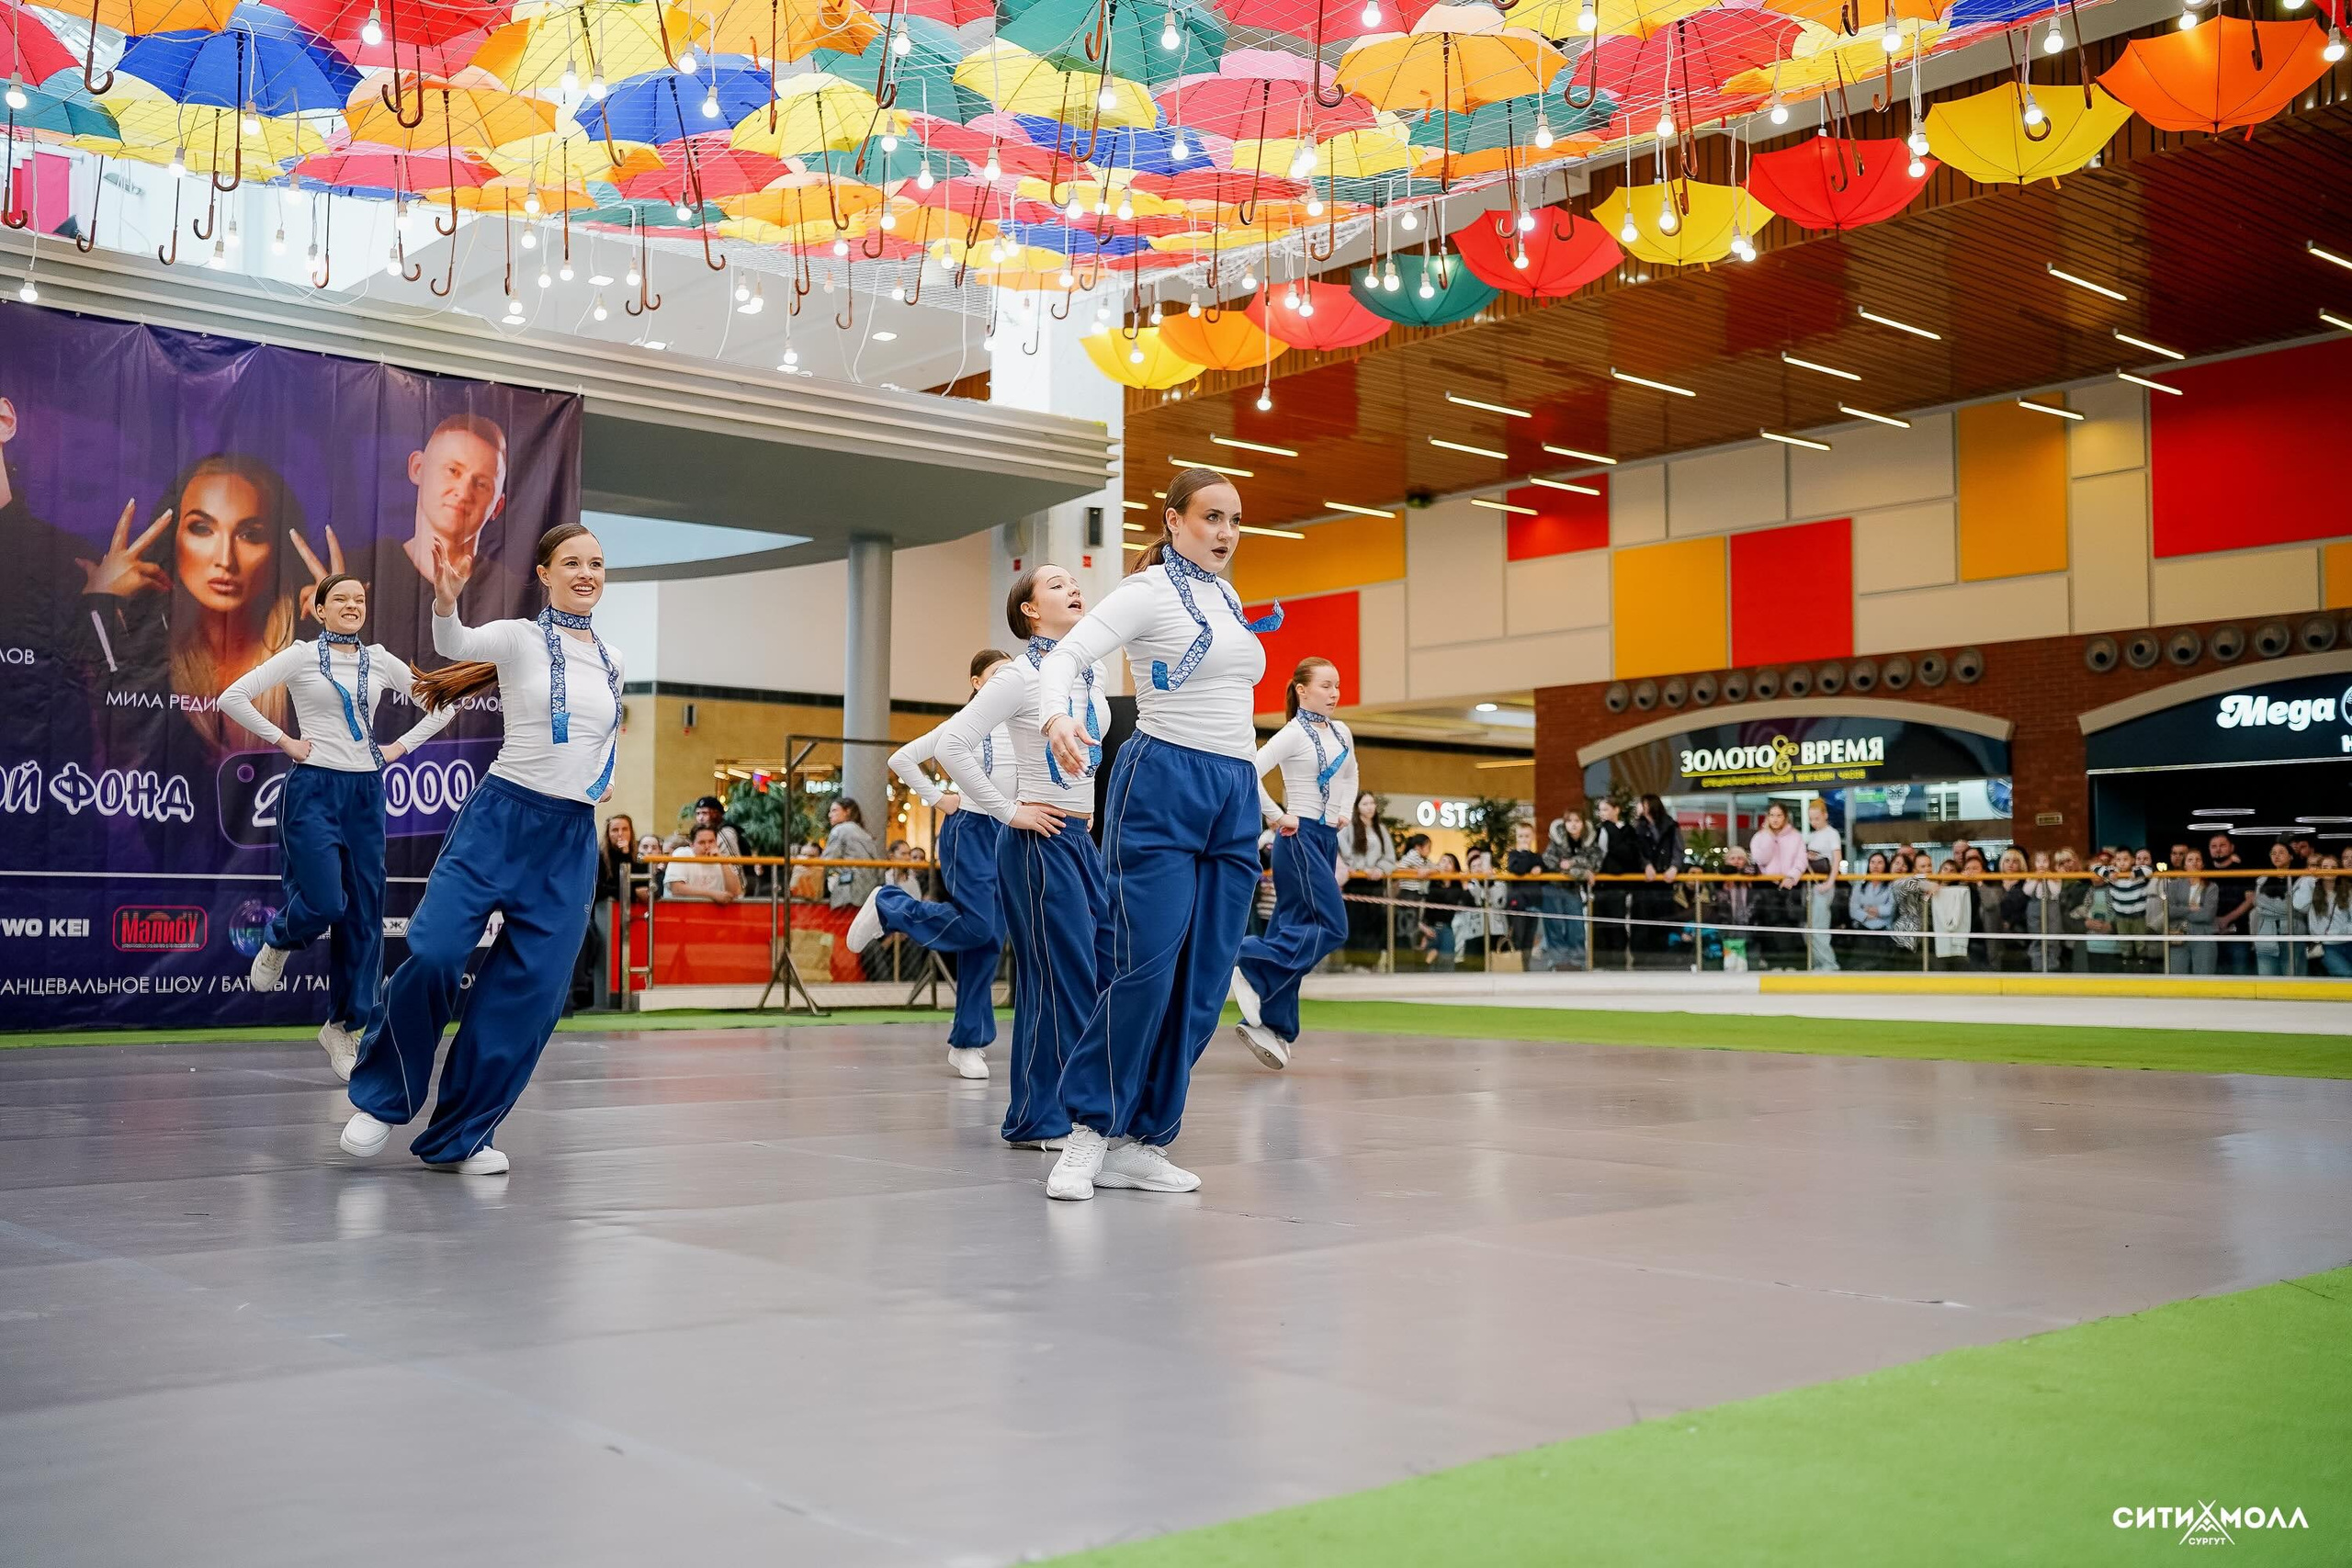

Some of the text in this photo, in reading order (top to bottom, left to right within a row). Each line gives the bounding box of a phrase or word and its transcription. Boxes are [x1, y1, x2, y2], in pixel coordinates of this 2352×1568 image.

[106, 691, 221, 714] МИЛА РЕДИ
[2216, 694, 2335, 731] Mega
[1679, 744, 1777, 773] ЗОЛОТО
[1801, 736, 1884, 765] ВРЕМЯ
[49, 761, 195, 823] ФОНД
[49, 919, 90, 937] KEI
[0, 976, 150, 996] АНЦЕВАЛЬНОЕ
[155, 976, 204, 994] ШОУ
